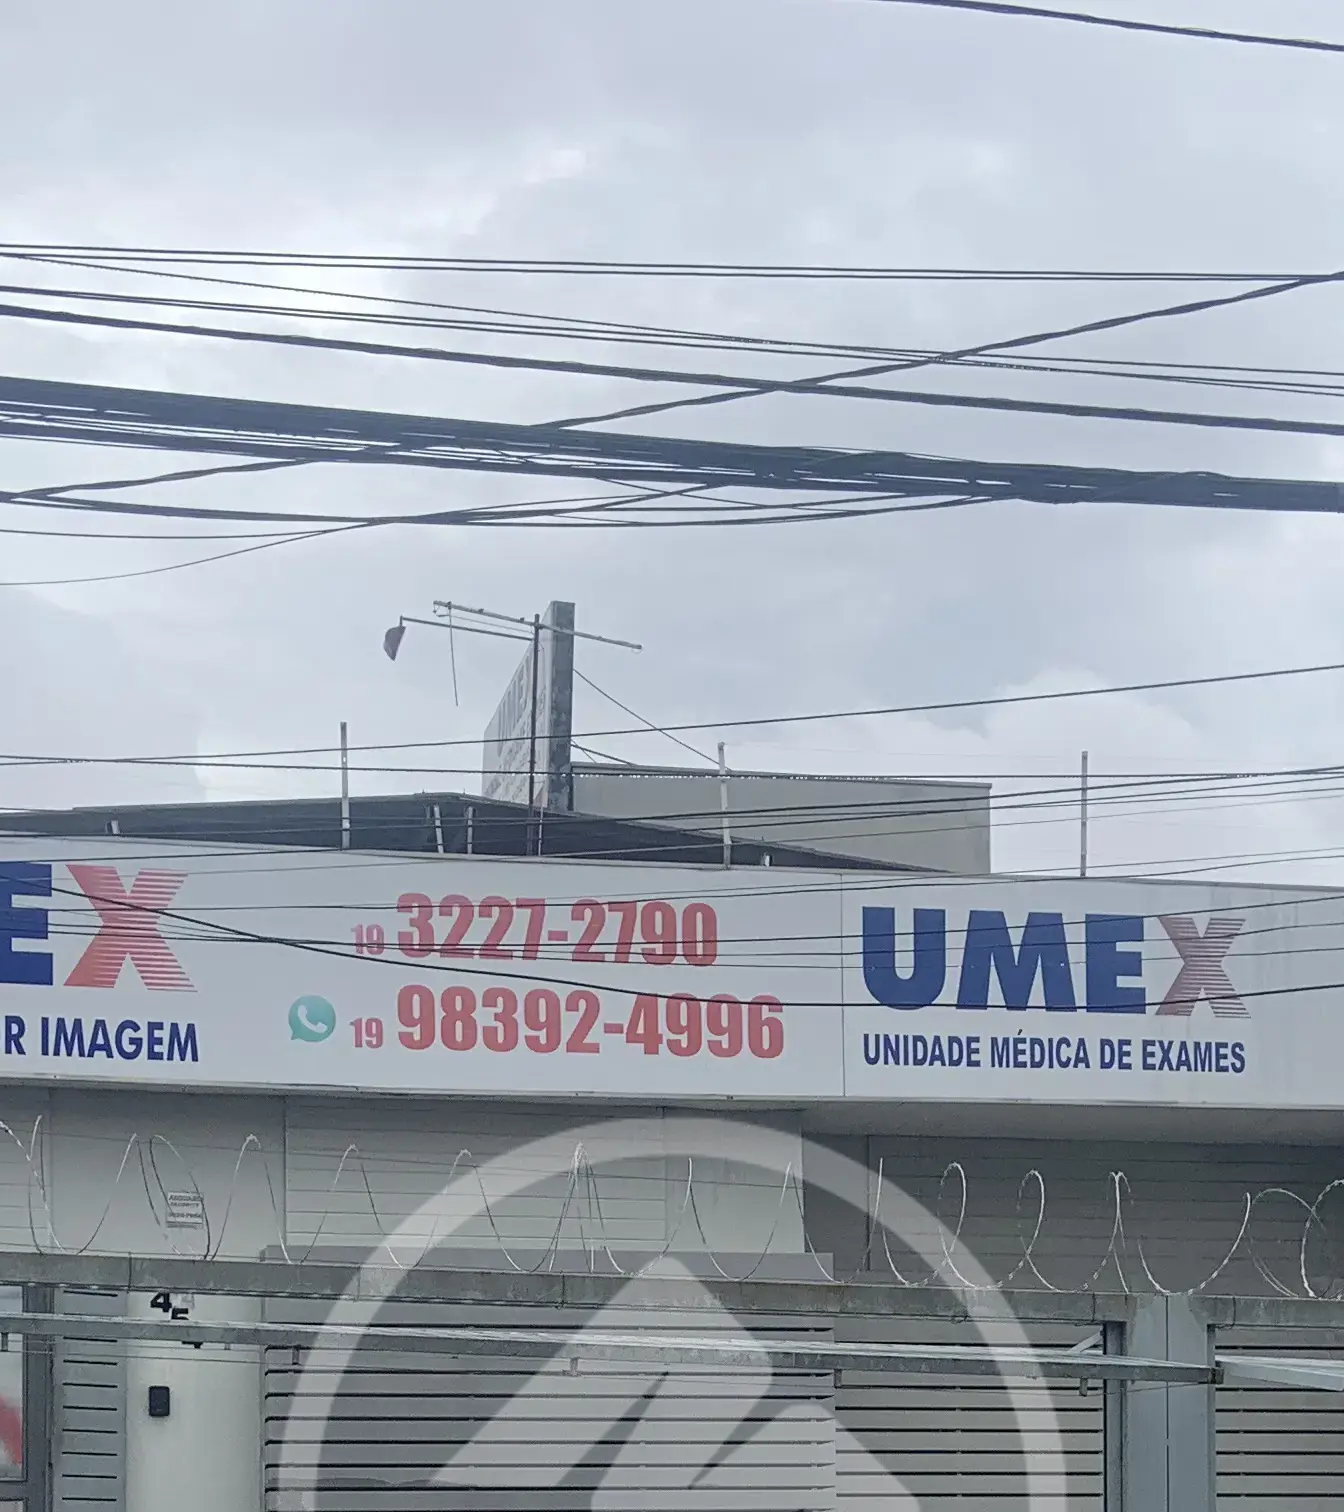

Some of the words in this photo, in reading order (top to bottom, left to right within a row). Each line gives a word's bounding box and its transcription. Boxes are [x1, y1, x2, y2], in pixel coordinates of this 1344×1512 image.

[350, 923, 384, 956] 19
[396, 892, 718, 967] 3227-2790
[861, 907, 1252, 1019] UMEX
[41, 1015, 199, 1062] IMAGEM
[349, 1017, 383, 1049] 19
[397, 984, 785, 1059] 98392-4996
[863, 1033, 981, 1067] UNIDADE
[990, 1029, 1091, 1070] MÉDICA
[1099, 1038, 1132, 1070] DE
[1141, 1039, 1246, 1074] EXAMES
